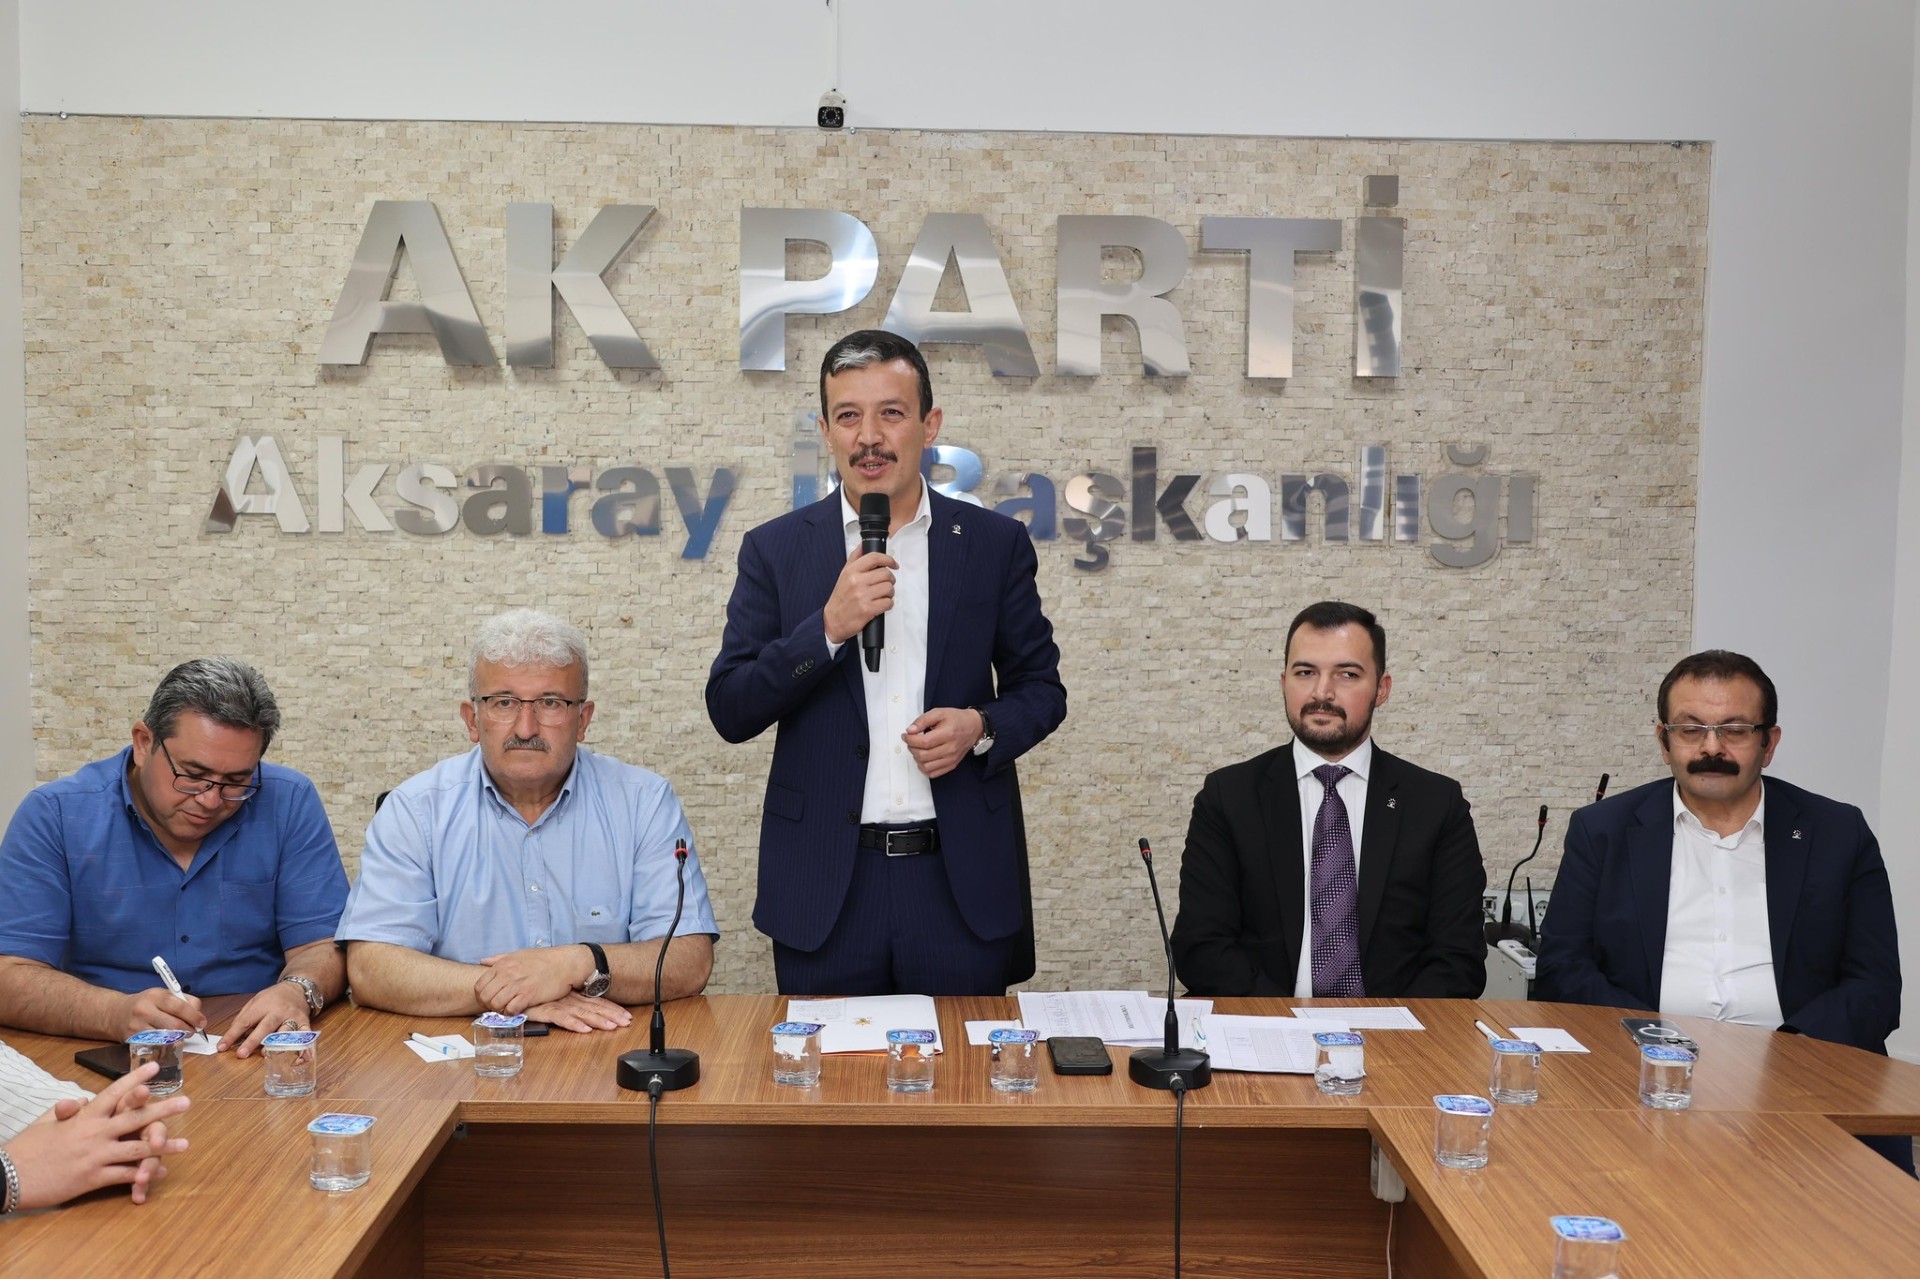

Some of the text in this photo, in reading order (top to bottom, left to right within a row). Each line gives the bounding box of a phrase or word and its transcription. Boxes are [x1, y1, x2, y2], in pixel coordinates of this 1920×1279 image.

[319, 175, 1403, 379] AK PARTİ
[205, 436, 738, 560] Aksaray
[793, 410, 840, 513] İ
